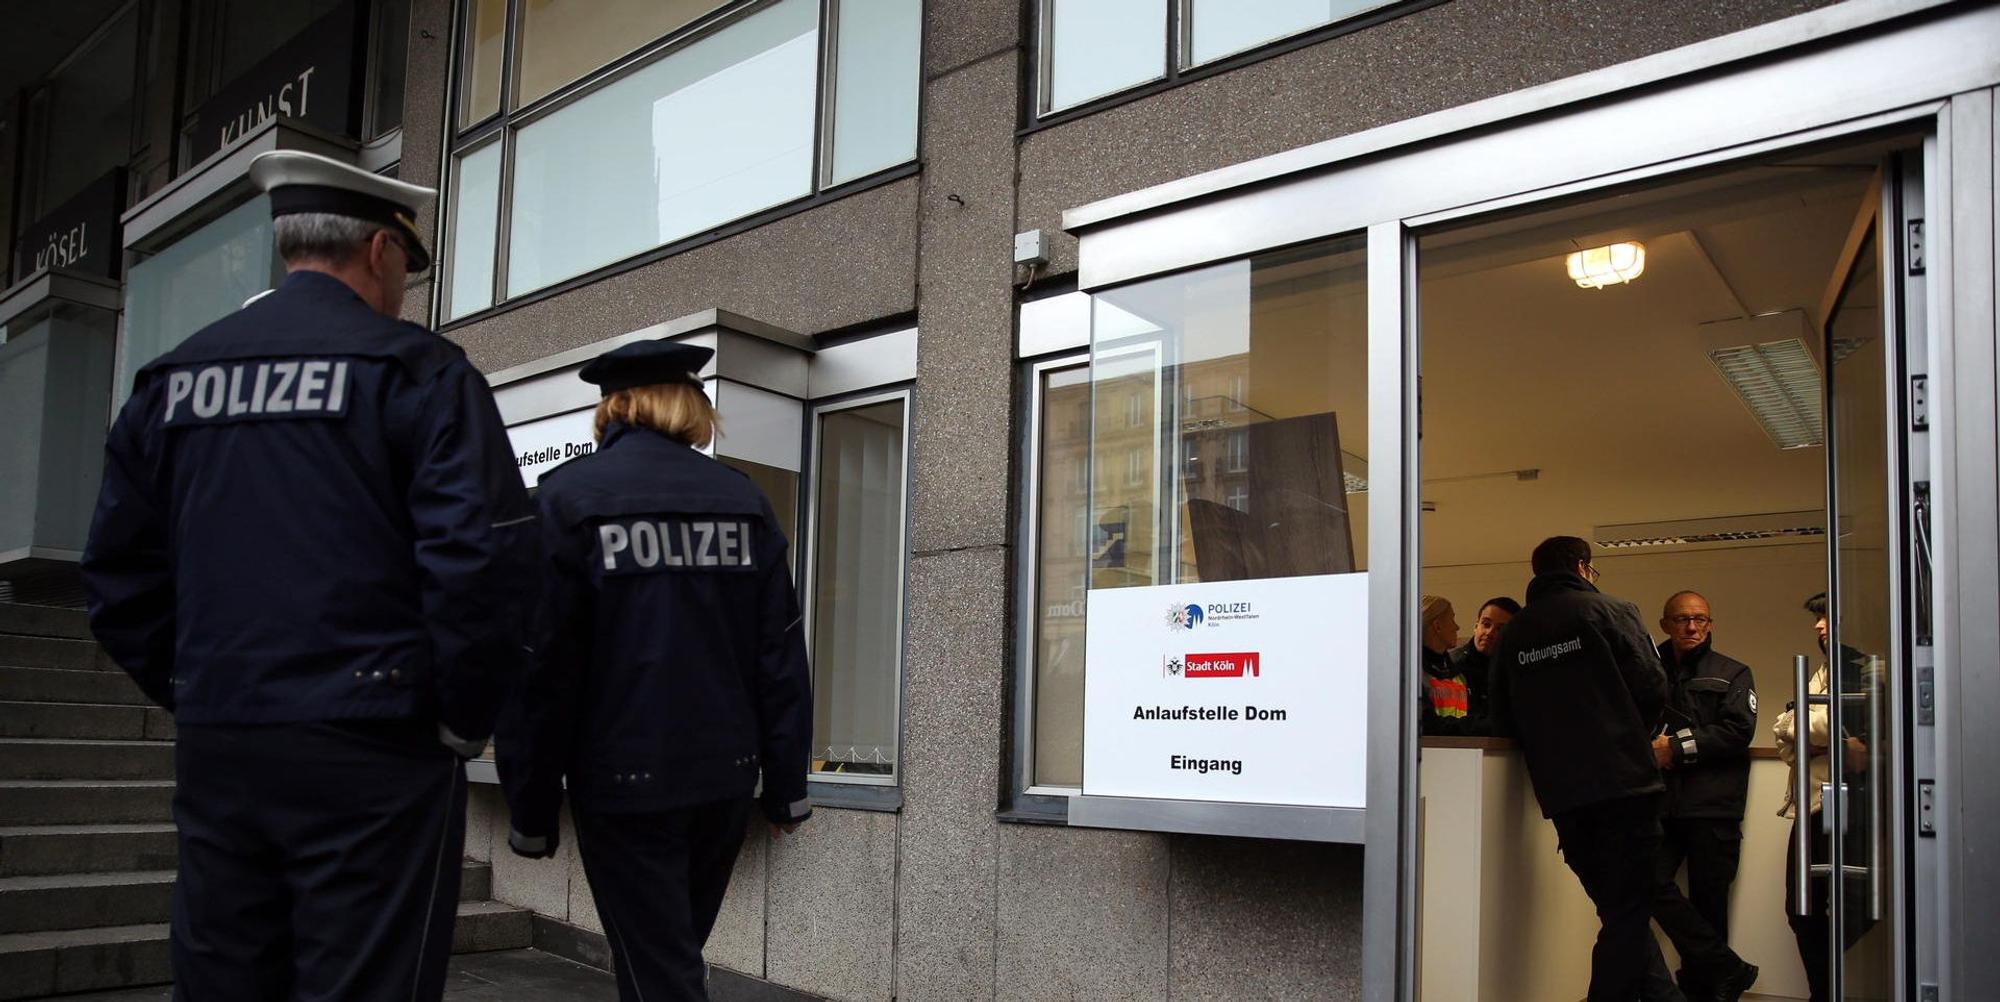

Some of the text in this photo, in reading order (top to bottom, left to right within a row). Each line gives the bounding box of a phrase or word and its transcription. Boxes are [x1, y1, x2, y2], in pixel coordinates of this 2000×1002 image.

[164, 361, 348, 423] POLIZEI
[515, 442, 593, 467] ufstelle Dom
[599, 520, 752, 570] POLIZEI
[1208, 602, 1251, 614] POLIZEI
[1518, 636, 1582, 665] Ordnungsamt
[1186, 660, 1235, 671] Stadt Köln
[1133, 705, 1287, 721] Anlaufstelle Dom
[1170, 755, 1242, 775] Eingang
